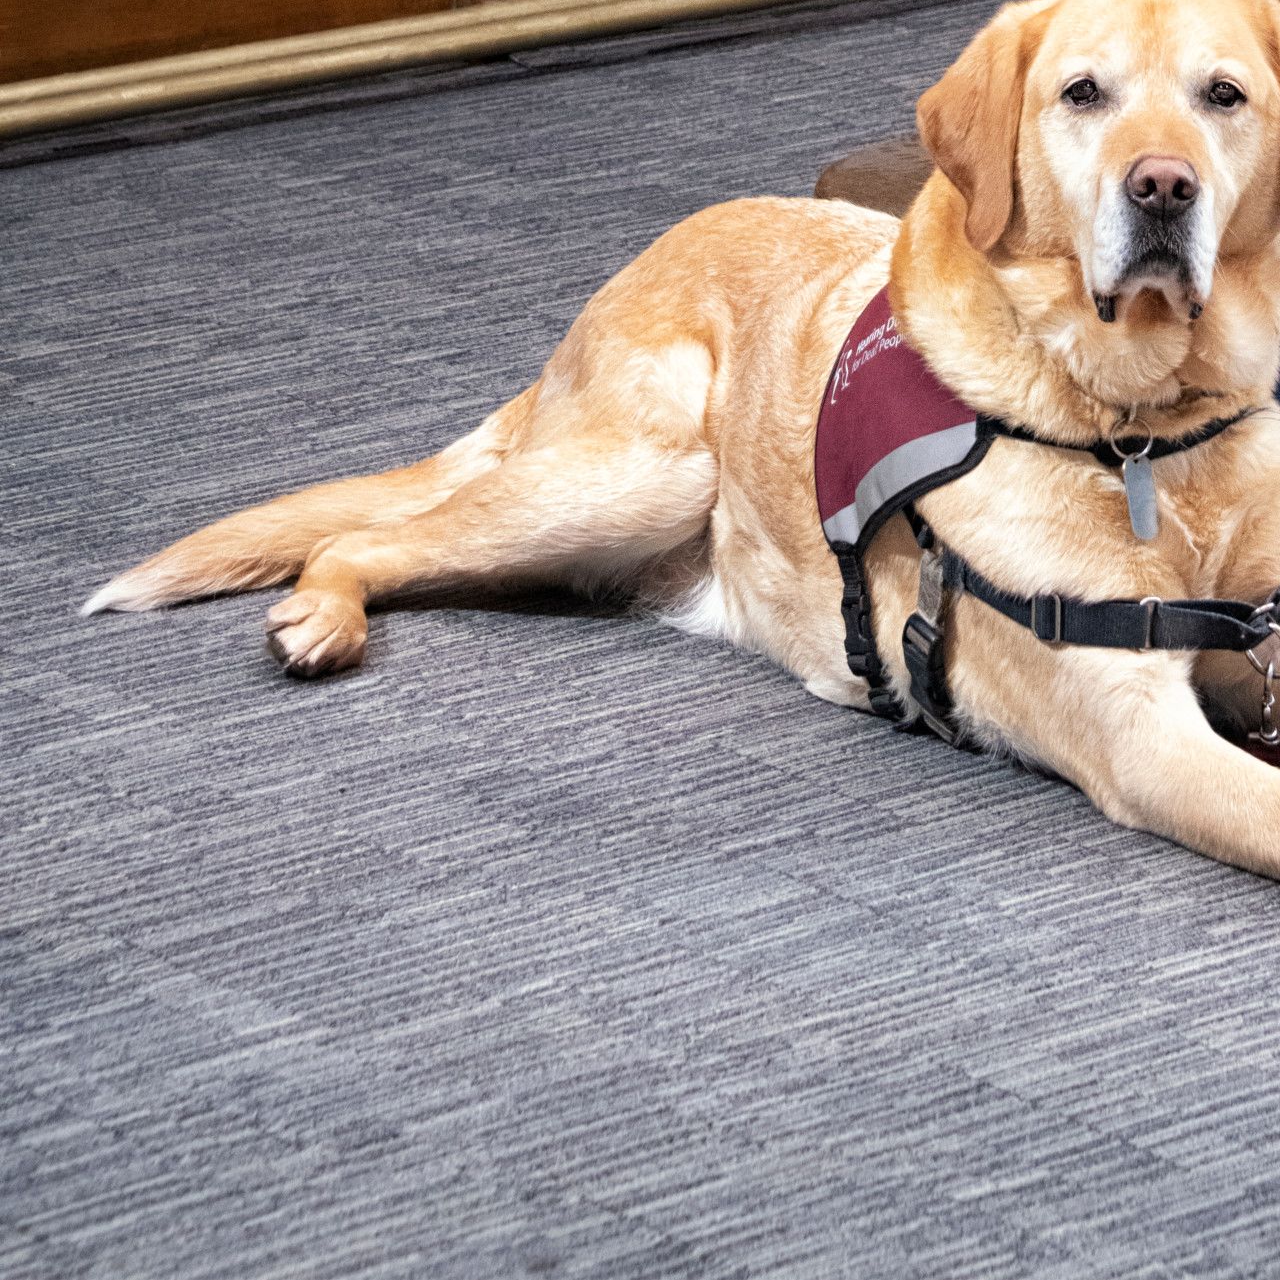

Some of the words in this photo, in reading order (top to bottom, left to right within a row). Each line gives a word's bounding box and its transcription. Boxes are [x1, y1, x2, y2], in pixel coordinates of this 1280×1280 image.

[856, 323, 886, 356] Hearing
[851, 357, 862, 374] for
[861, 340, 880, 365] Deaf
